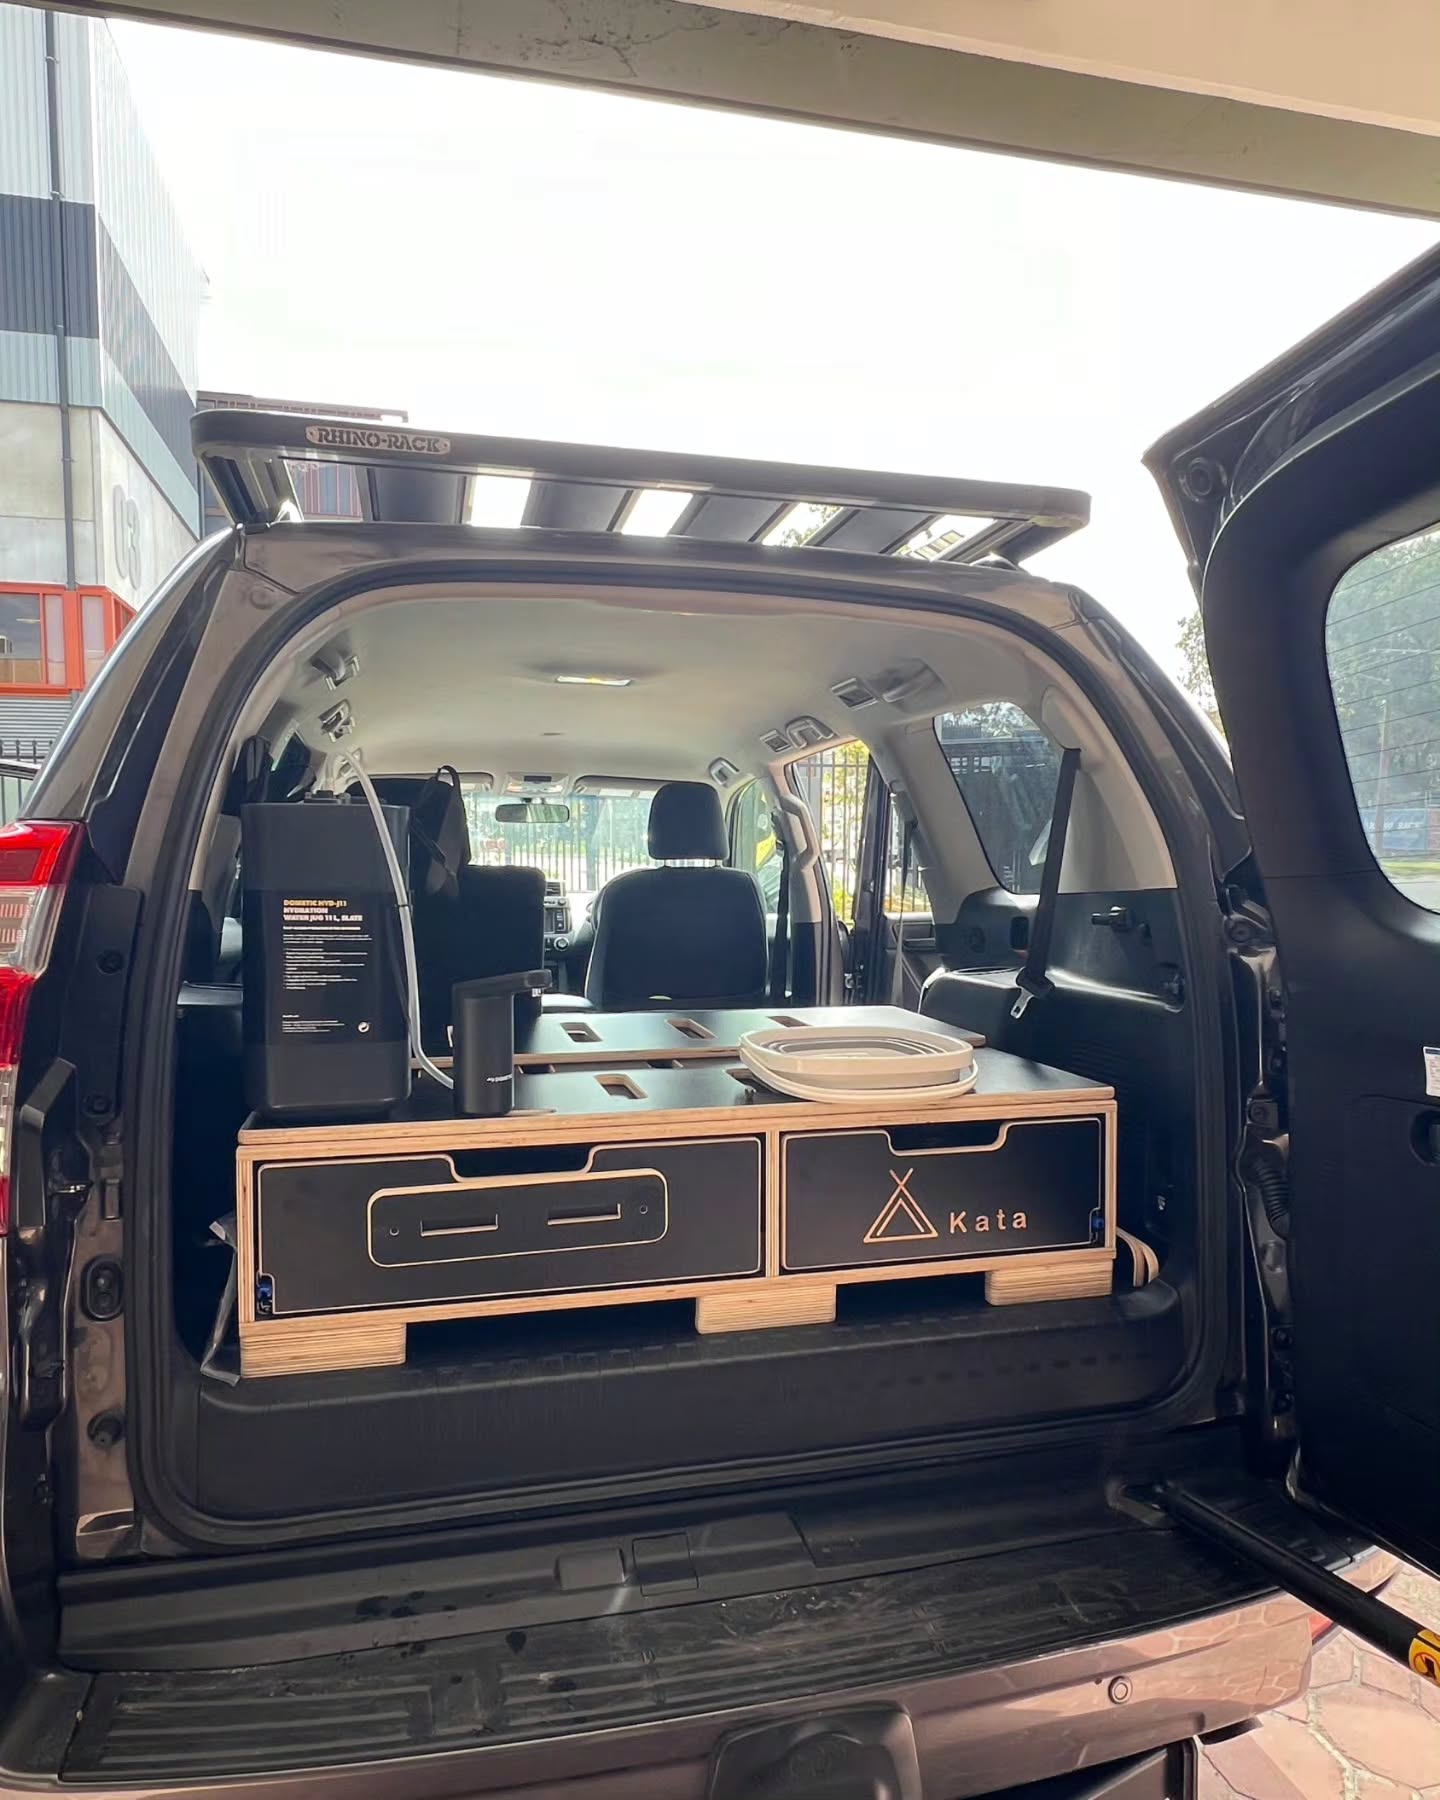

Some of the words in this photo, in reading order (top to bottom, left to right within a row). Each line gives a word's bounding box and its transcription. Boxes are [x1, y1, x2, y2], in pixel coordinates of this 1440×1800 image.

[317, 428, 441, 453] RHINO-RACK
[113, 484, 141, 591] 03
[950, 1208, 1028, 1234] Kata
